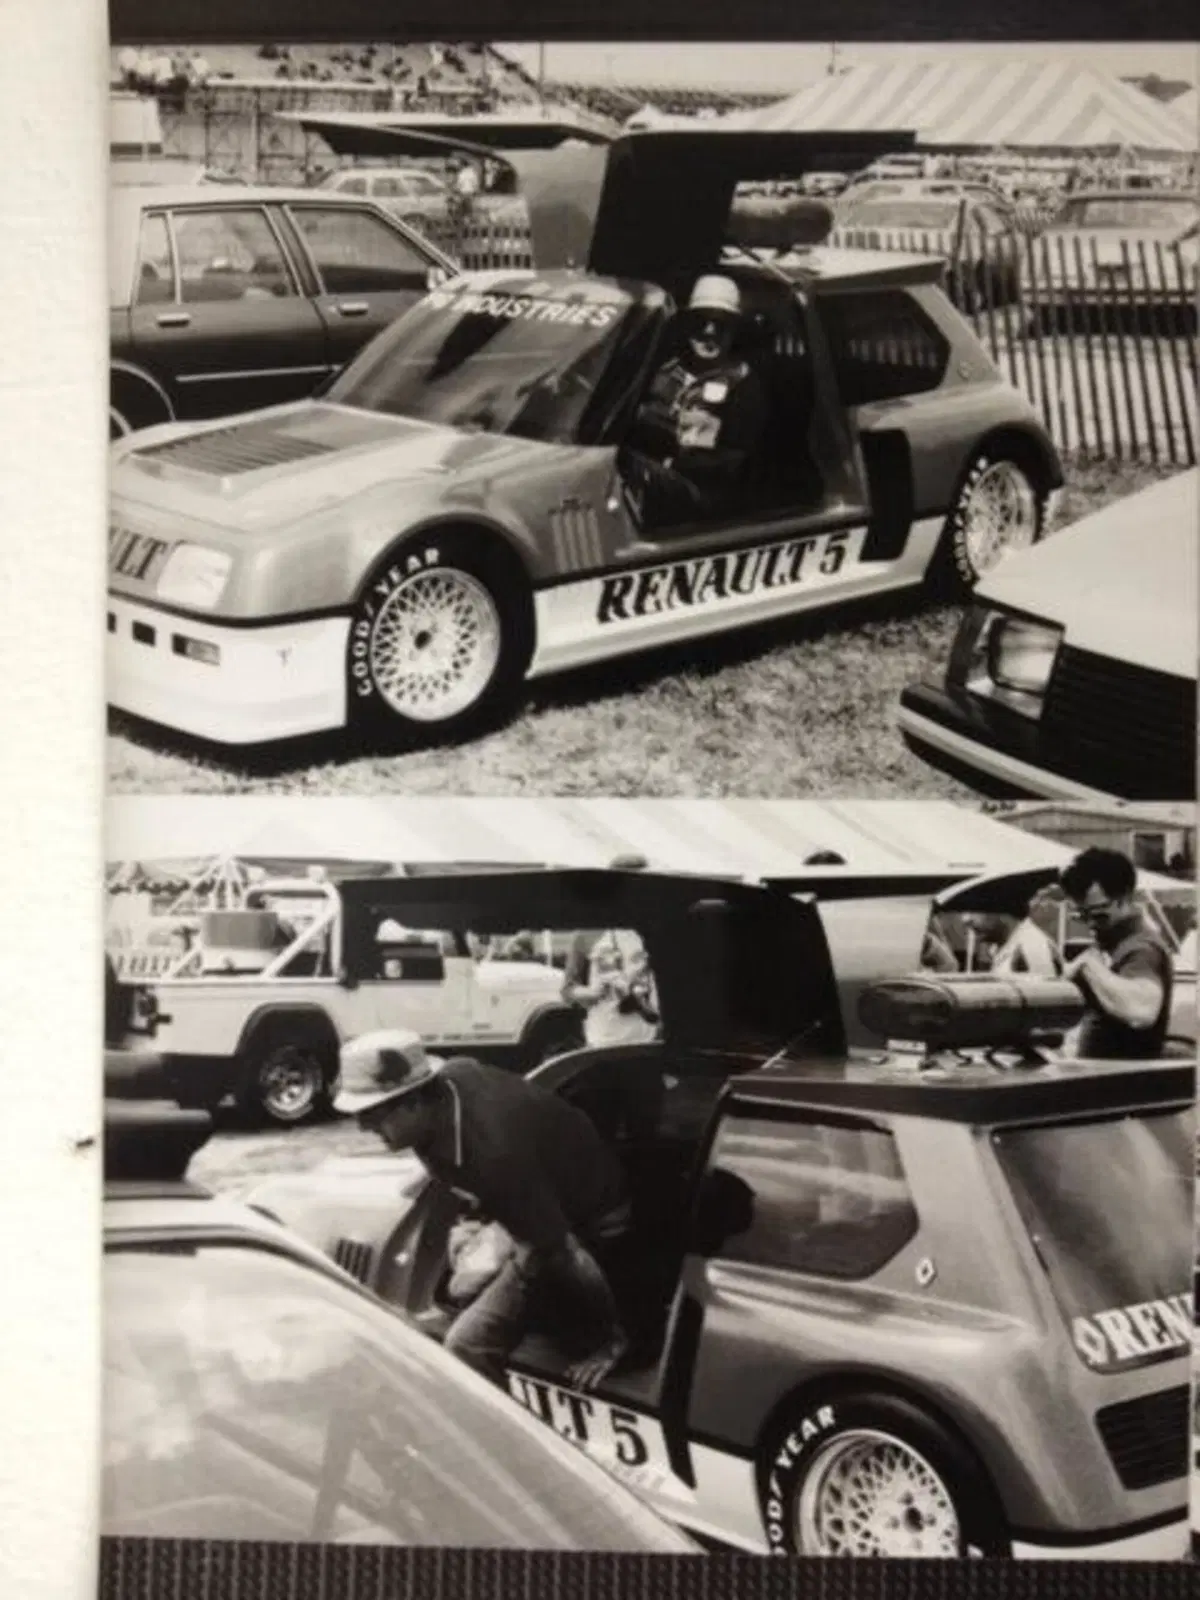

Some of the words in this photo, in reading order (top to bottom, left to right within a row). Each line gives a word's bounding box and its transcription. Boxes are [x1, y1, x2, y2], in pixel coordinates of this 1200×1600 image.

[596, 538, 816, 624] RENAULT
[819, 531, 849, 576] 5
[609, 1406, 649, 1468] 5
